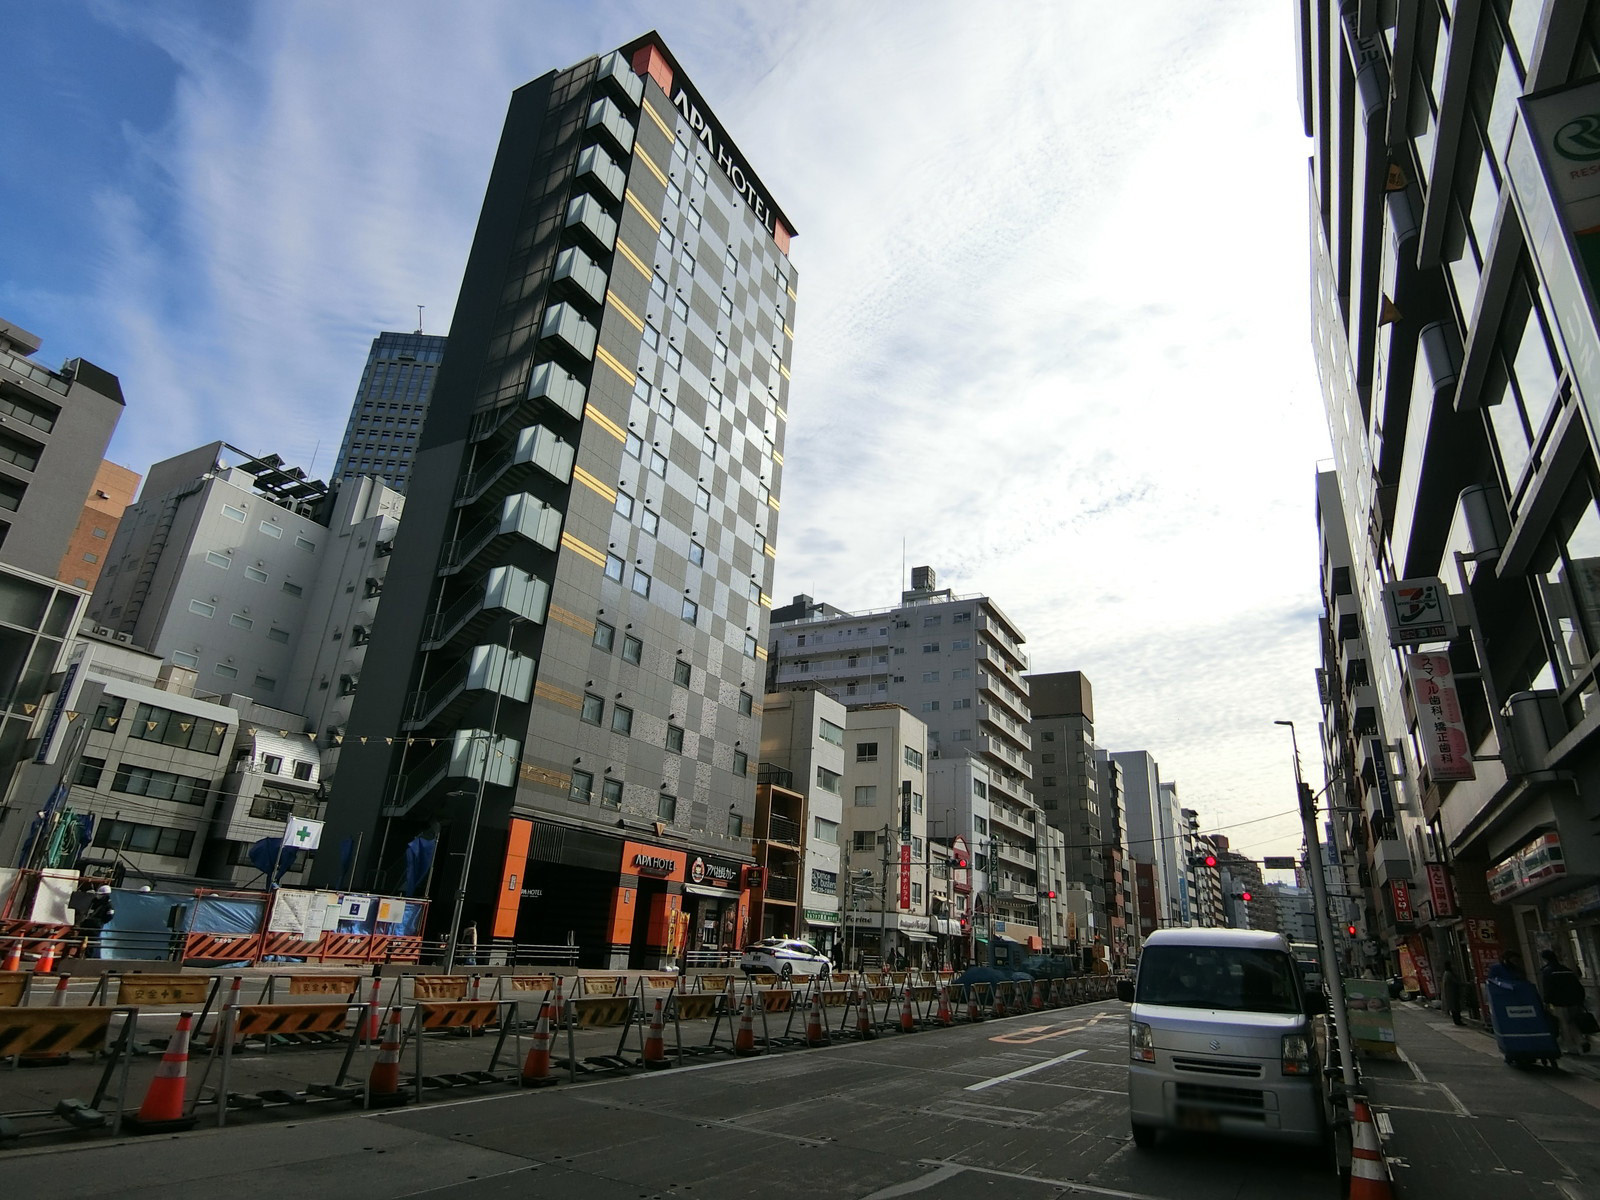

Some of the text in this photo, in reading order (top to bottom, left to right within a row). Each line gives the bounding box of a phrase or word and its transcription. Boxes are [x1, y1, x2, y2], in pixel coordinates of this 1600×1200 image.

[673, 88, 775, 234] APA HOTEL
[1570, 164, 1600, 180] RES
[1422, 657, 1453, 764] スマイル歯科・矯正歯科
[635, 854, 678, 871] APA HOTEL
